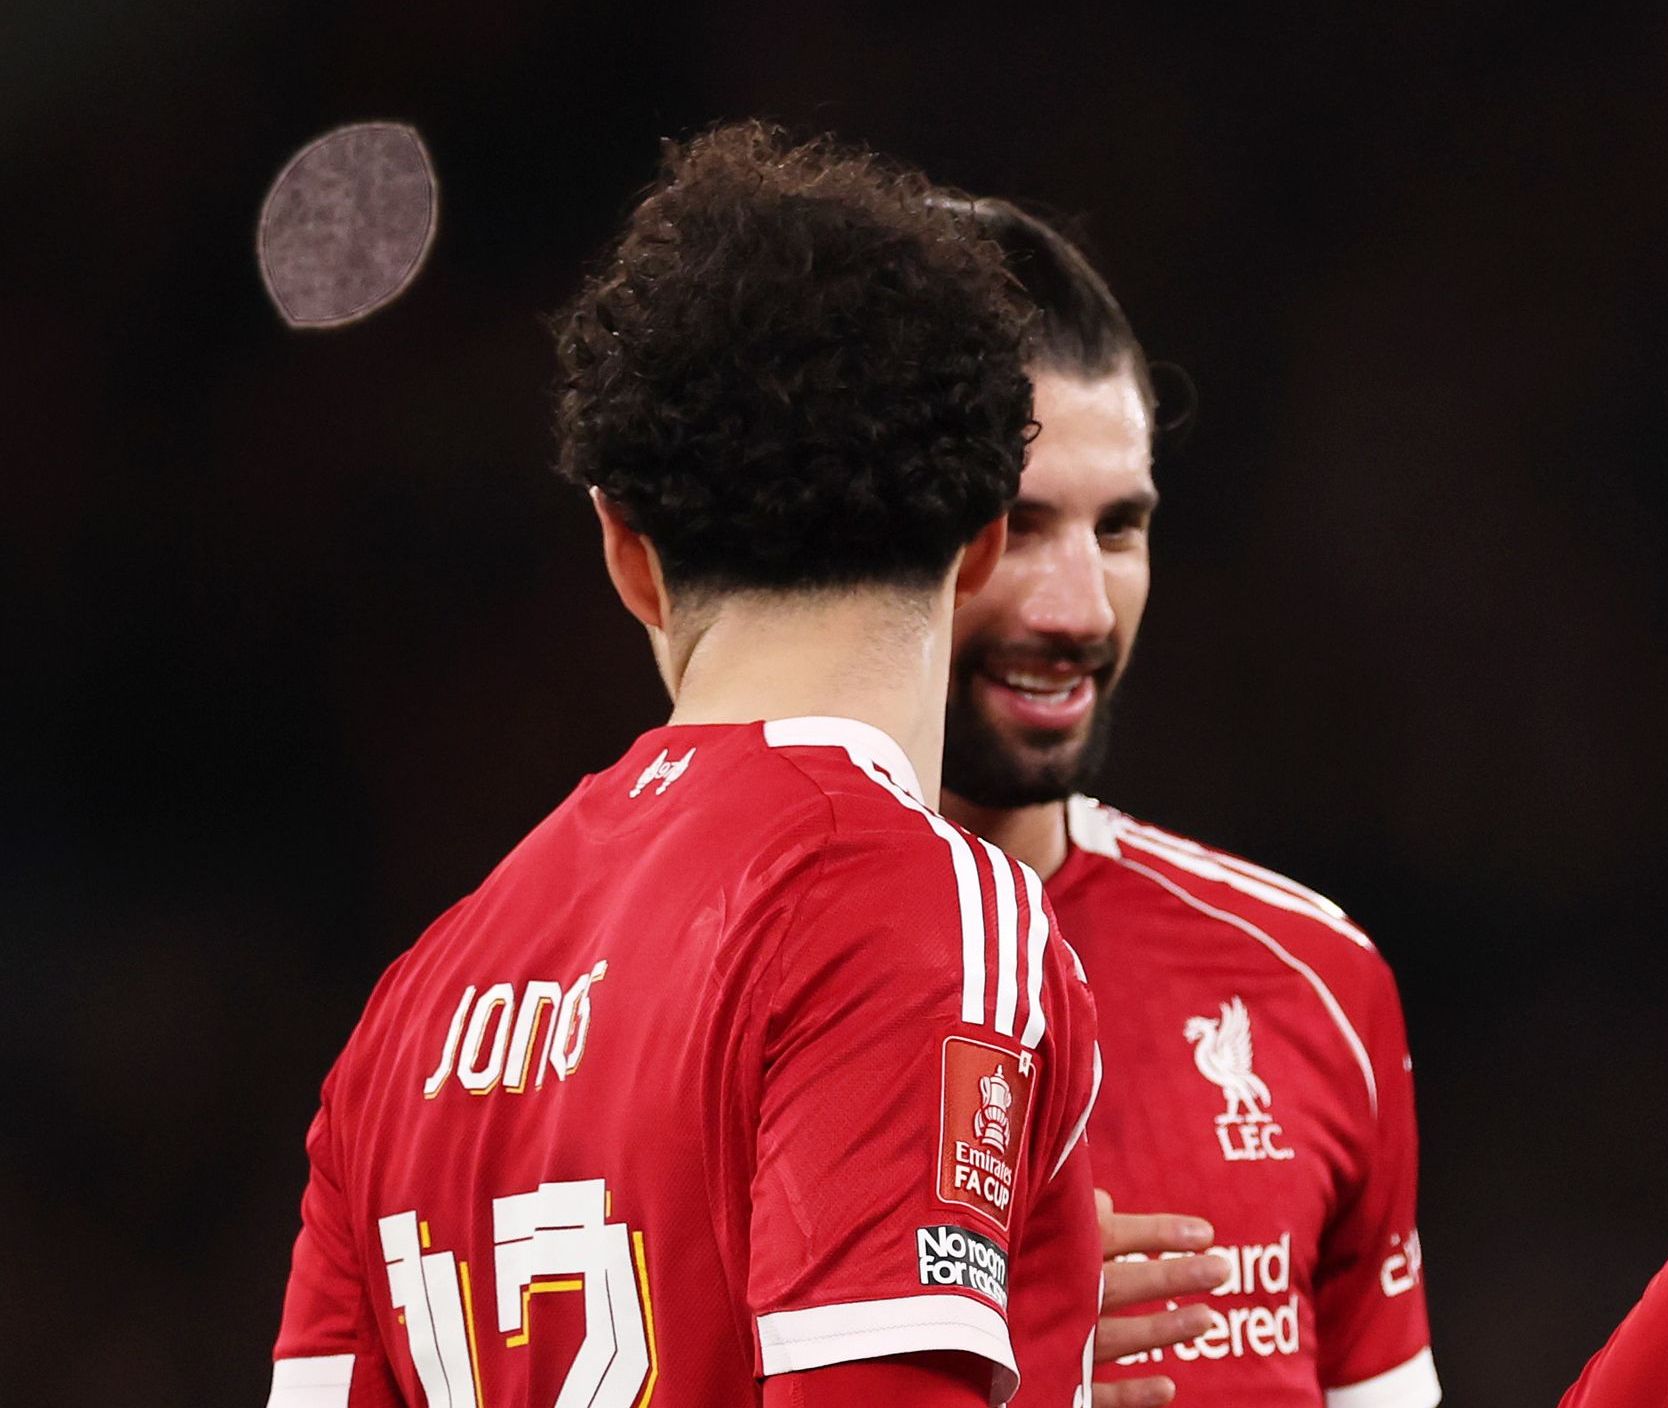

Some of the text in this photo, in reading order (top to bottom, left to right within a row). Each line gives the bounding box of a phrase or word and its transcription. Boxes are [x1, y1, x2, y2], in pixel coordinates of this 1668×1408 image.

[954, 1164, 1010, 1211] FA CUP
[916, 1226, 1006, 1286] No room
[919, 1255, 967, 1285] for
